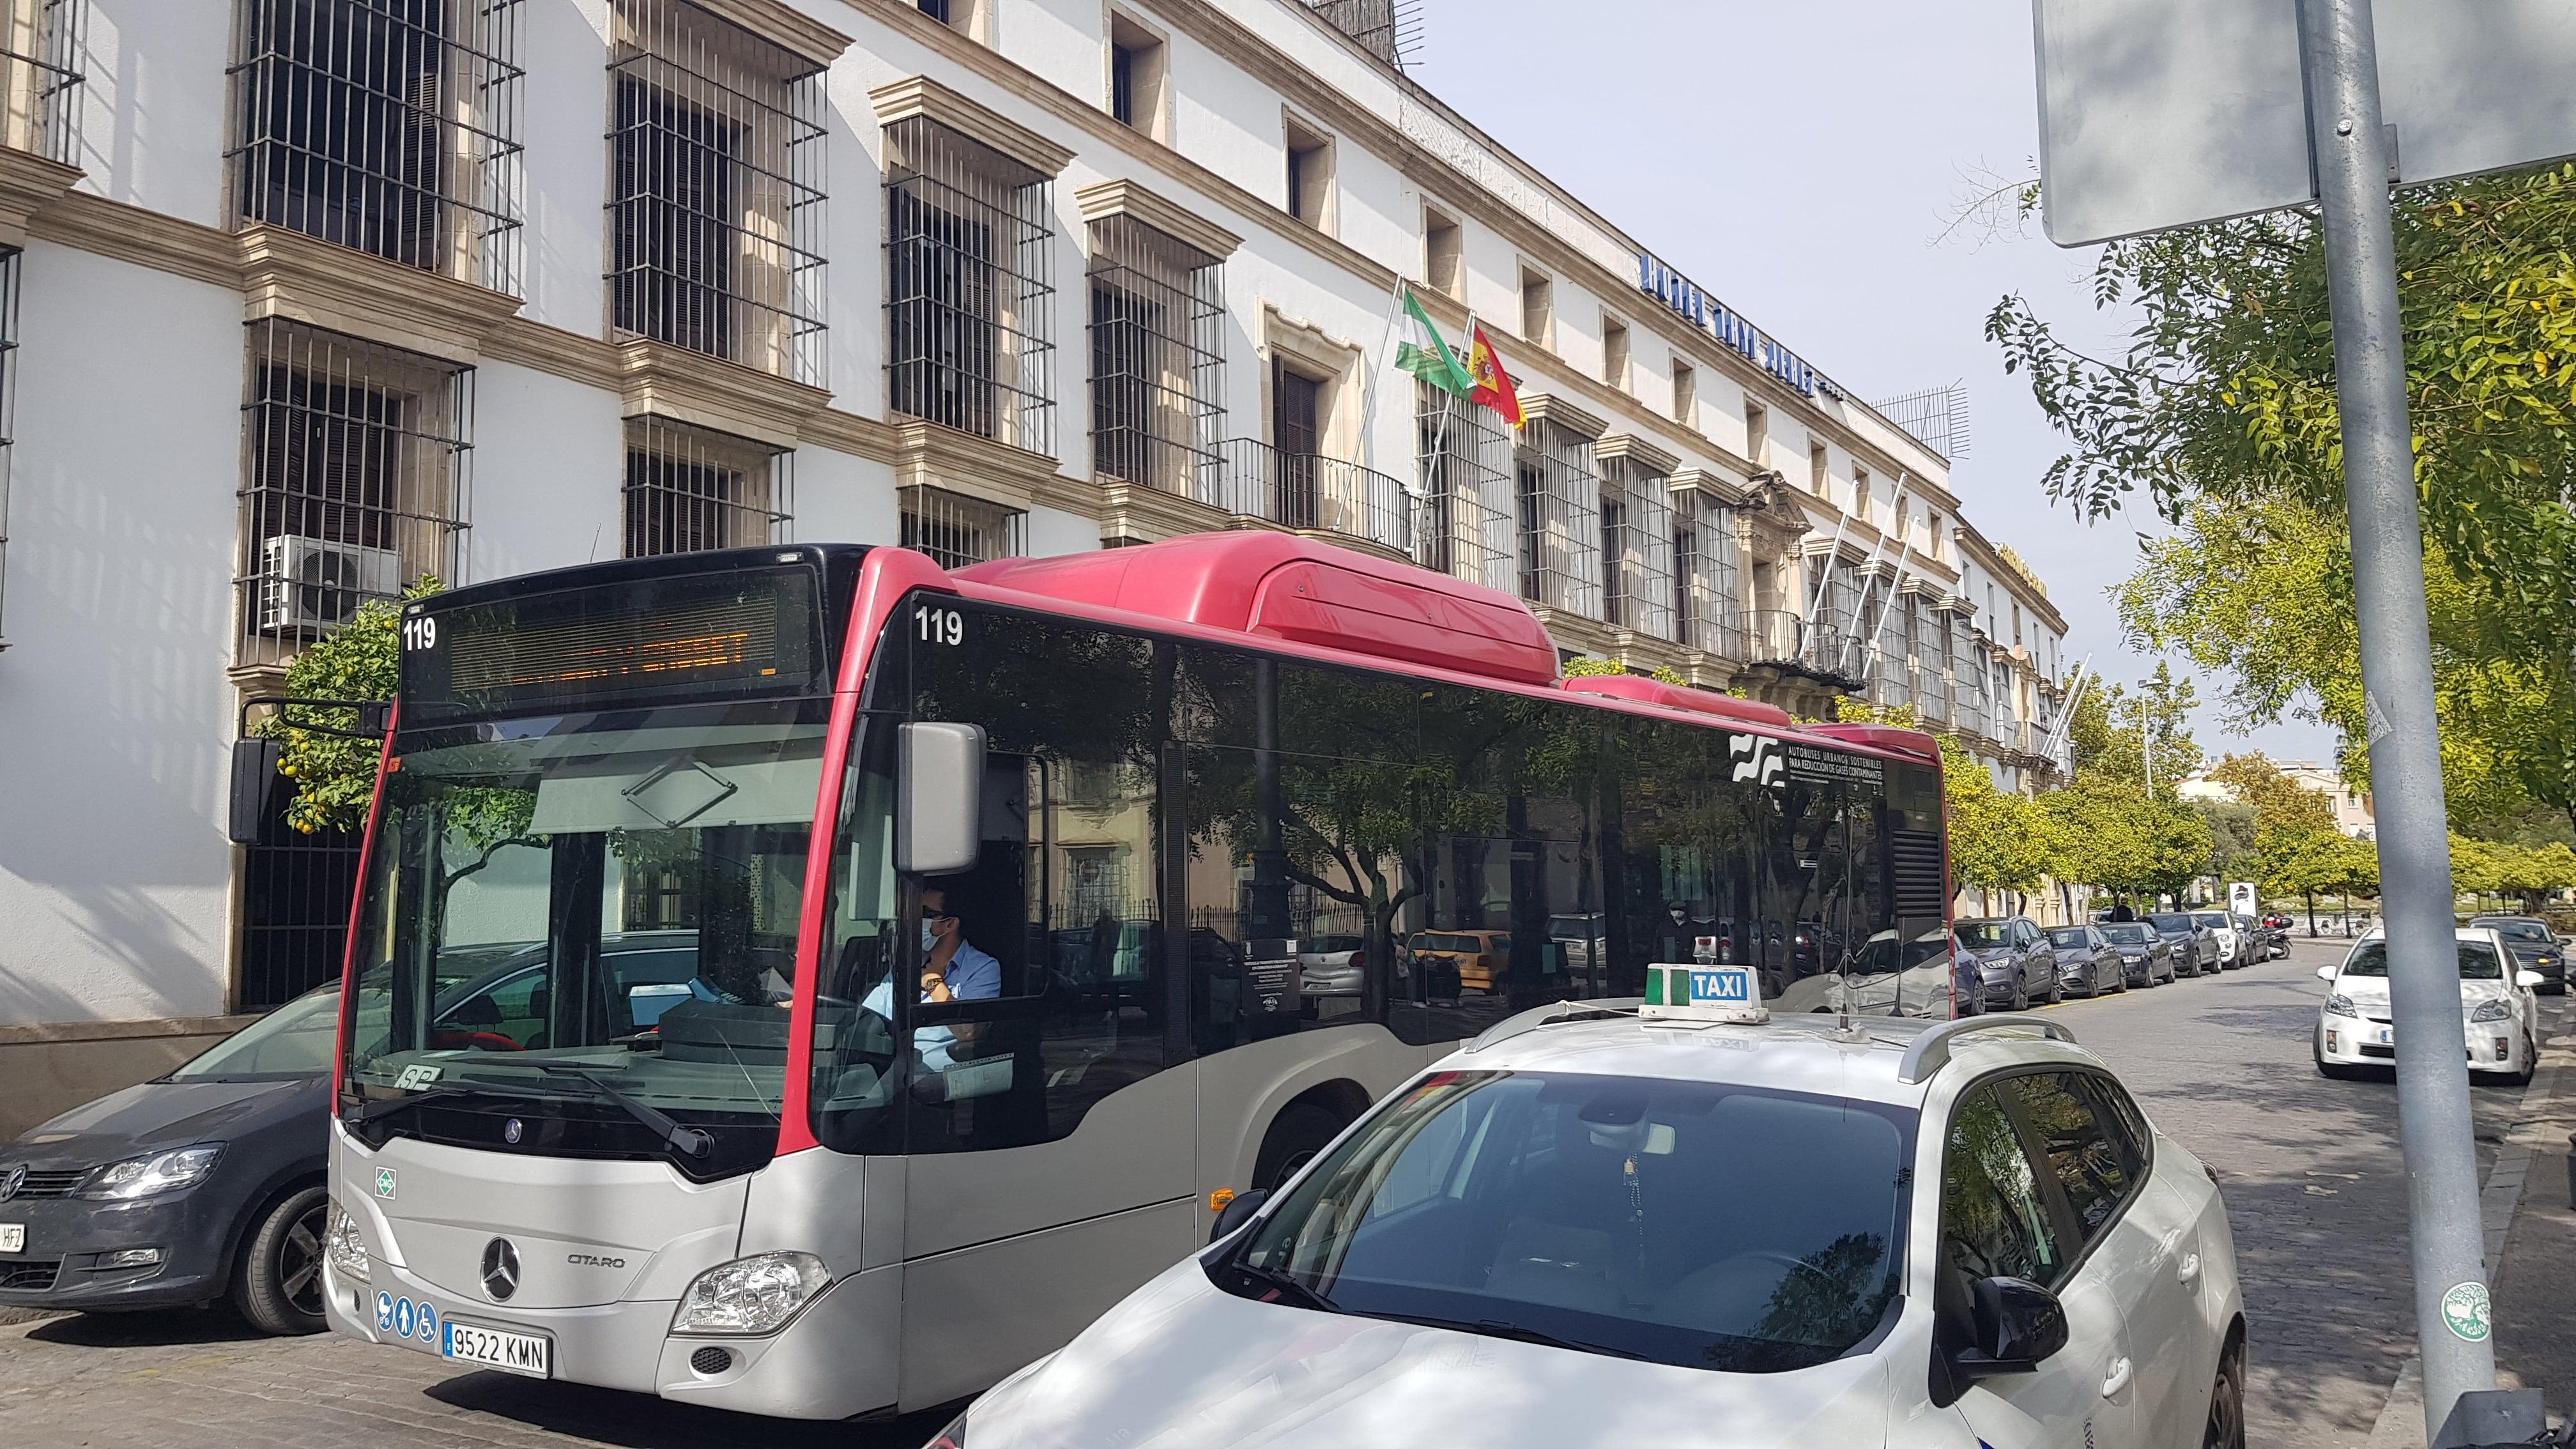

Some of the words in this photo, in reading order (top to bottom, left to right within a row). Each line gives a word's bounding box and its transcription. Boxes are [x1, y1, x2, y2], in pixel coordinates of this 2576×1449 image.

[1641, 255, 1707, 327] HOTEL
[1713, 305, 1761, 360] TRYP
[1765, 342, 1815, 398] JEREZ
[404, 617, 436, 651] 119
[916, 606, 963, 646] 119
[1788, 746, 1820, 760] AUTOBUSES
[1823, 751, 1848, 765] URBANOS
[1850, 756, 1882, 770] SOSTENIBLES
[1788, 757, 1801, 768] PARA
[1828, 764, 1836, 774] DE
[1836, 765, 1848, 775] GASES
[1694, 975, 1742, 997] TAXI
[379, 1178, 392, 1189] CNG
[3, 1227, 22, 1248] HFZ
[567, 1254, 626, 1268] CITARO
[454, 1329, 500, 1361] 9522
[506, 1337, 542, 1368] KMN
